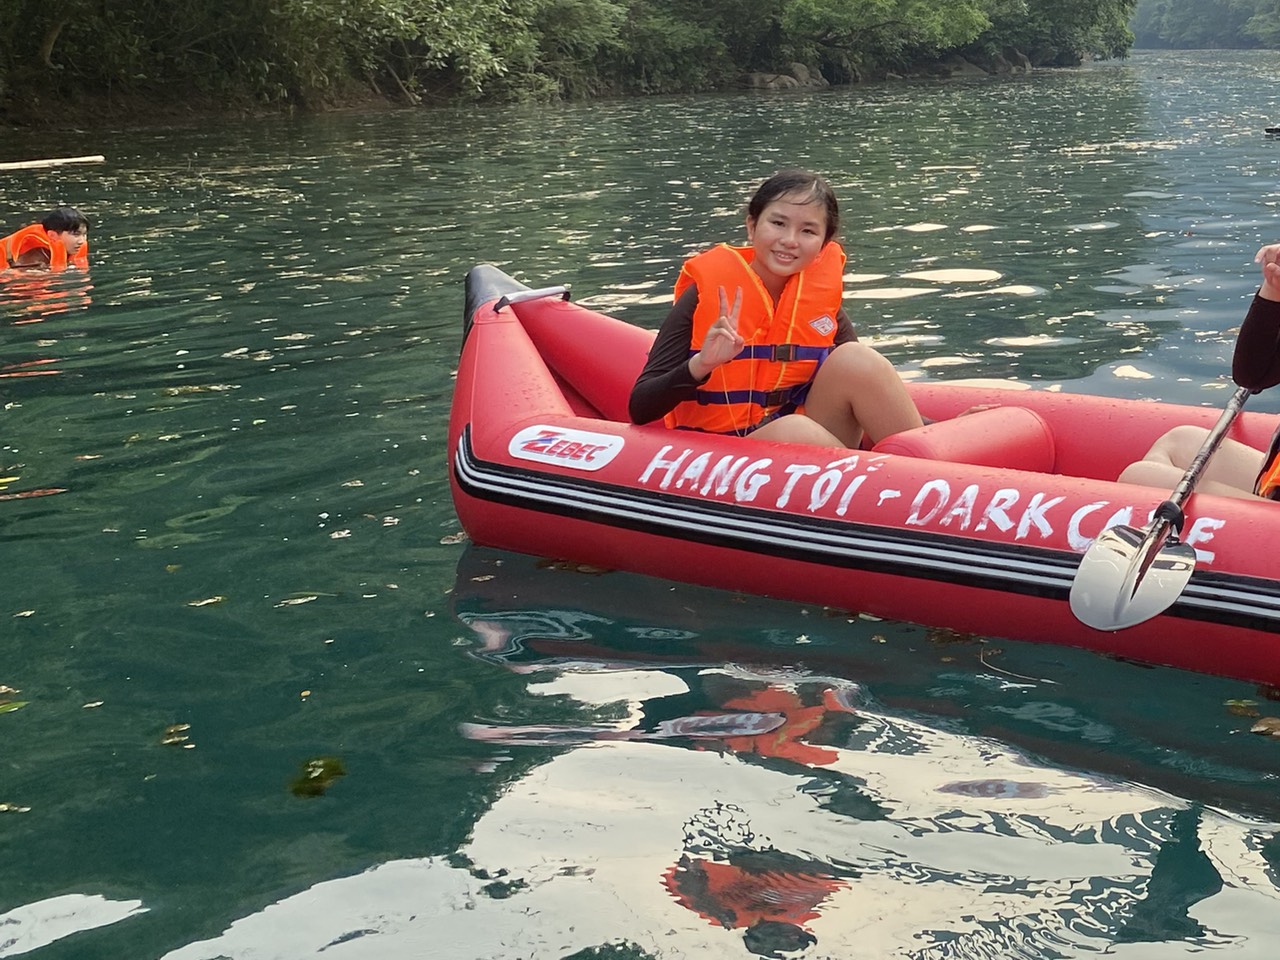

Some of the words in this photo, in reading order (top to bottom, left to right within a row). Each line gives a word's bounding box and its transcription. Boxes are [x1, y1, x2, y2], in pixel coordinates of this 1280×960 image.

[521, 429, 608, 462] ZEBEC
[638, 445, 773, 502] HANG
[904, 479, 1067, 541] DARK
[1067, 500, 1227, 565] CAE
